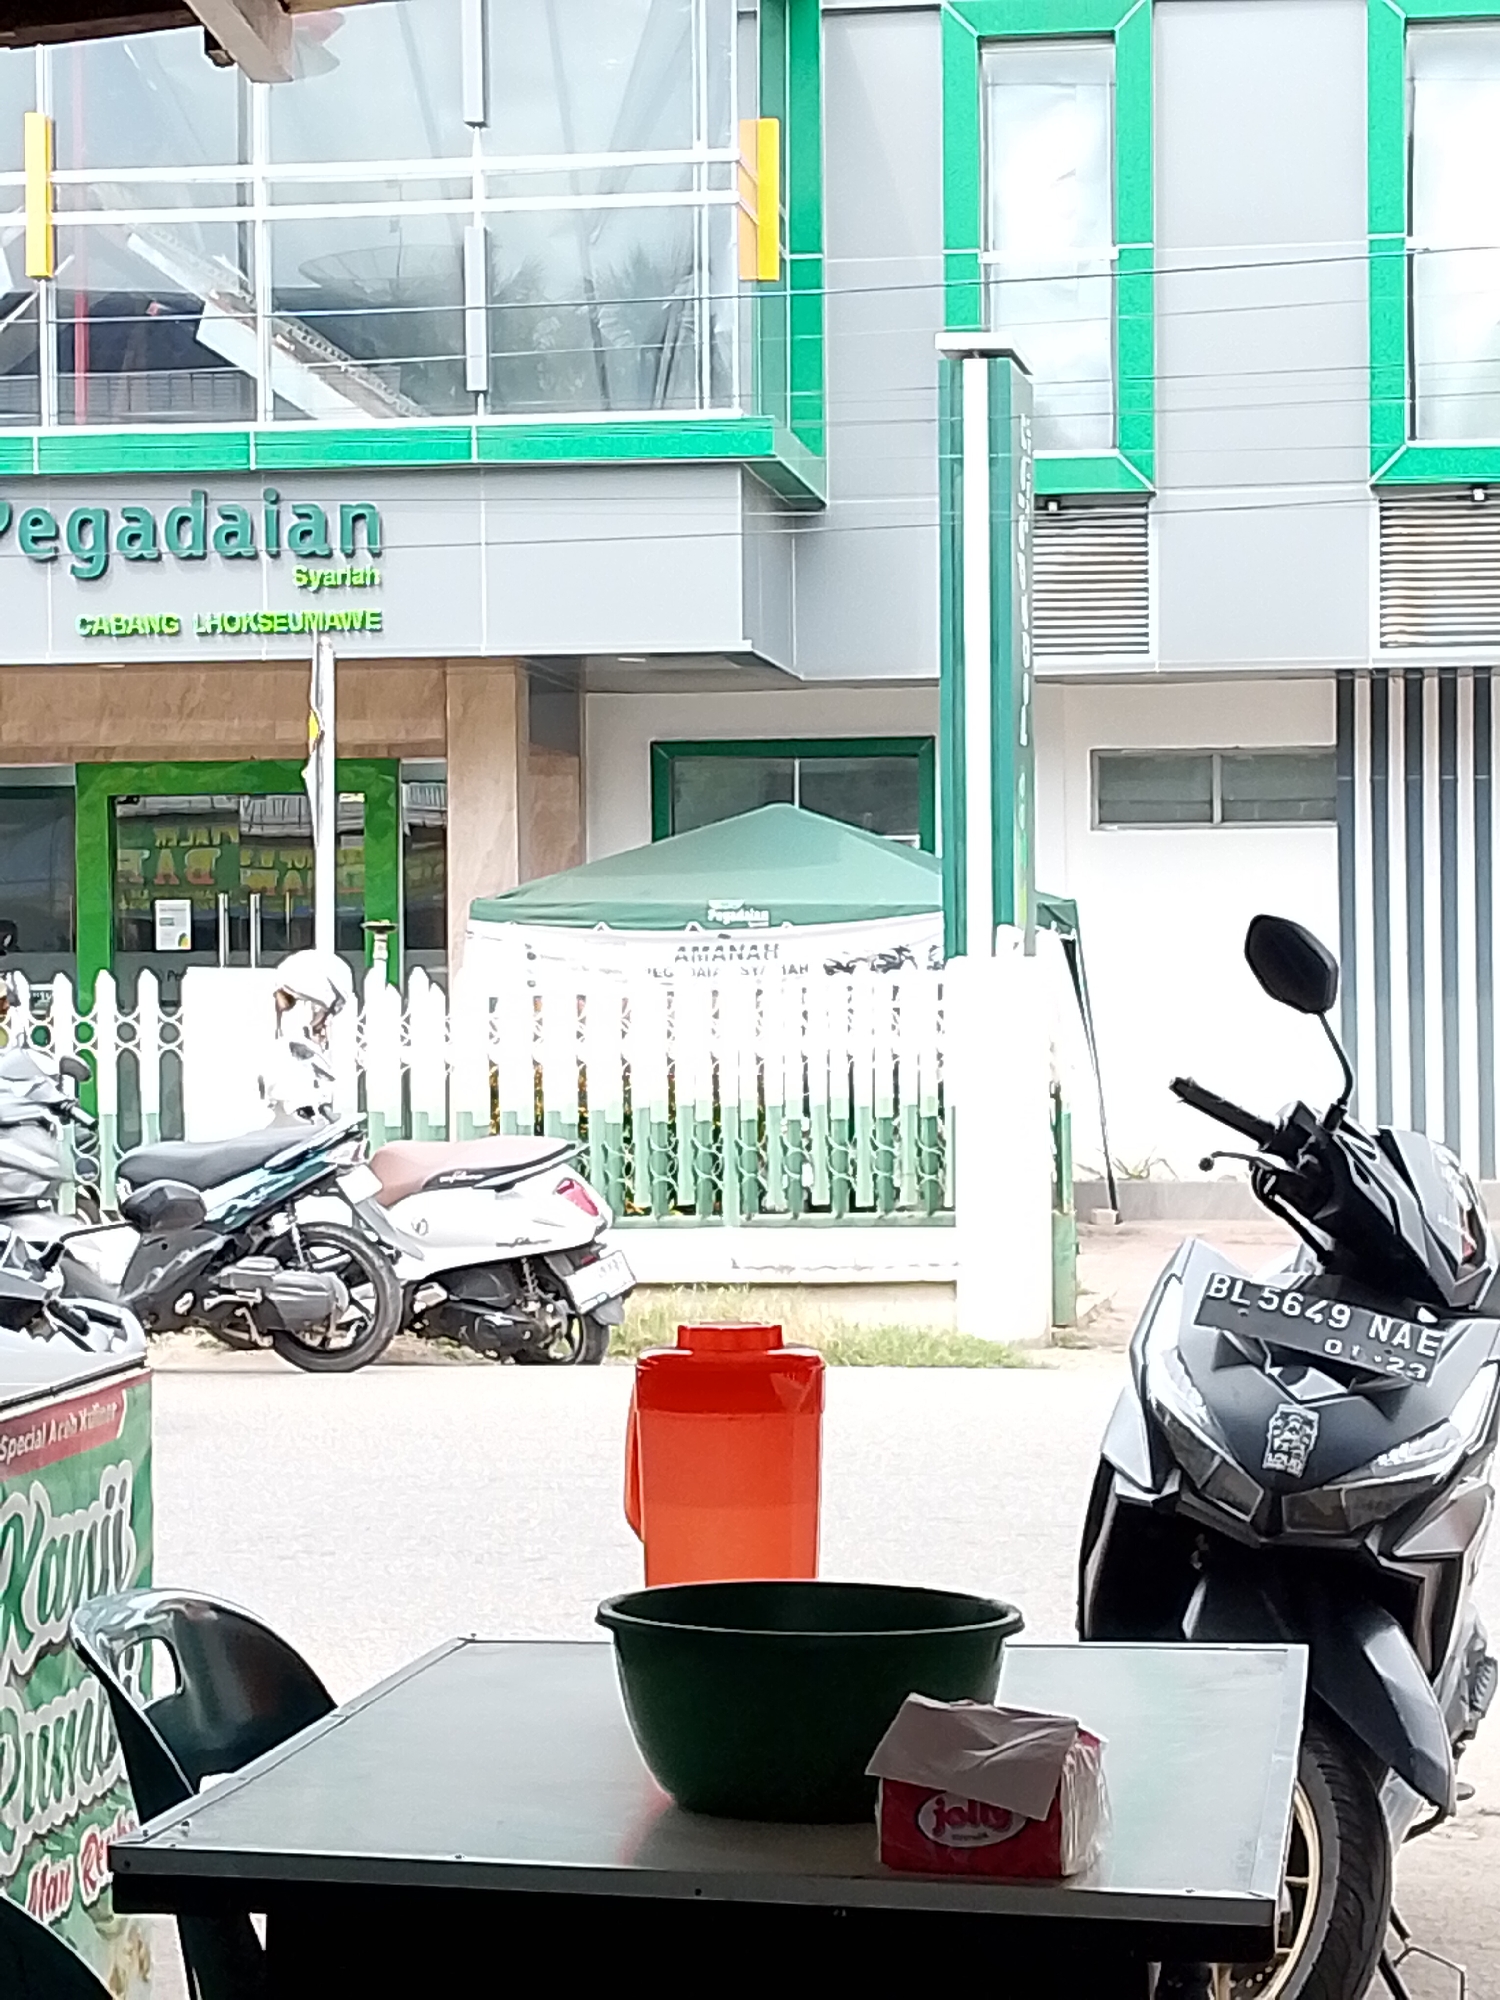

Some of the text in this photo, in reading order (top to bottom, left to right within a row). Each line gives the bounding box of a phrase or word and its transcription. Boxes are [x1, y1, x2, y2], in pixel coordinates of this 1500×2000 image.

[291, 563, 381, 592] Syariah
[74, 609, 382, 637] CABANG LHOKSEUMAWE
[1206, 1273, 1443, 1357] BL 5649 NAE
[0, 1421, 47, 1465] Special
